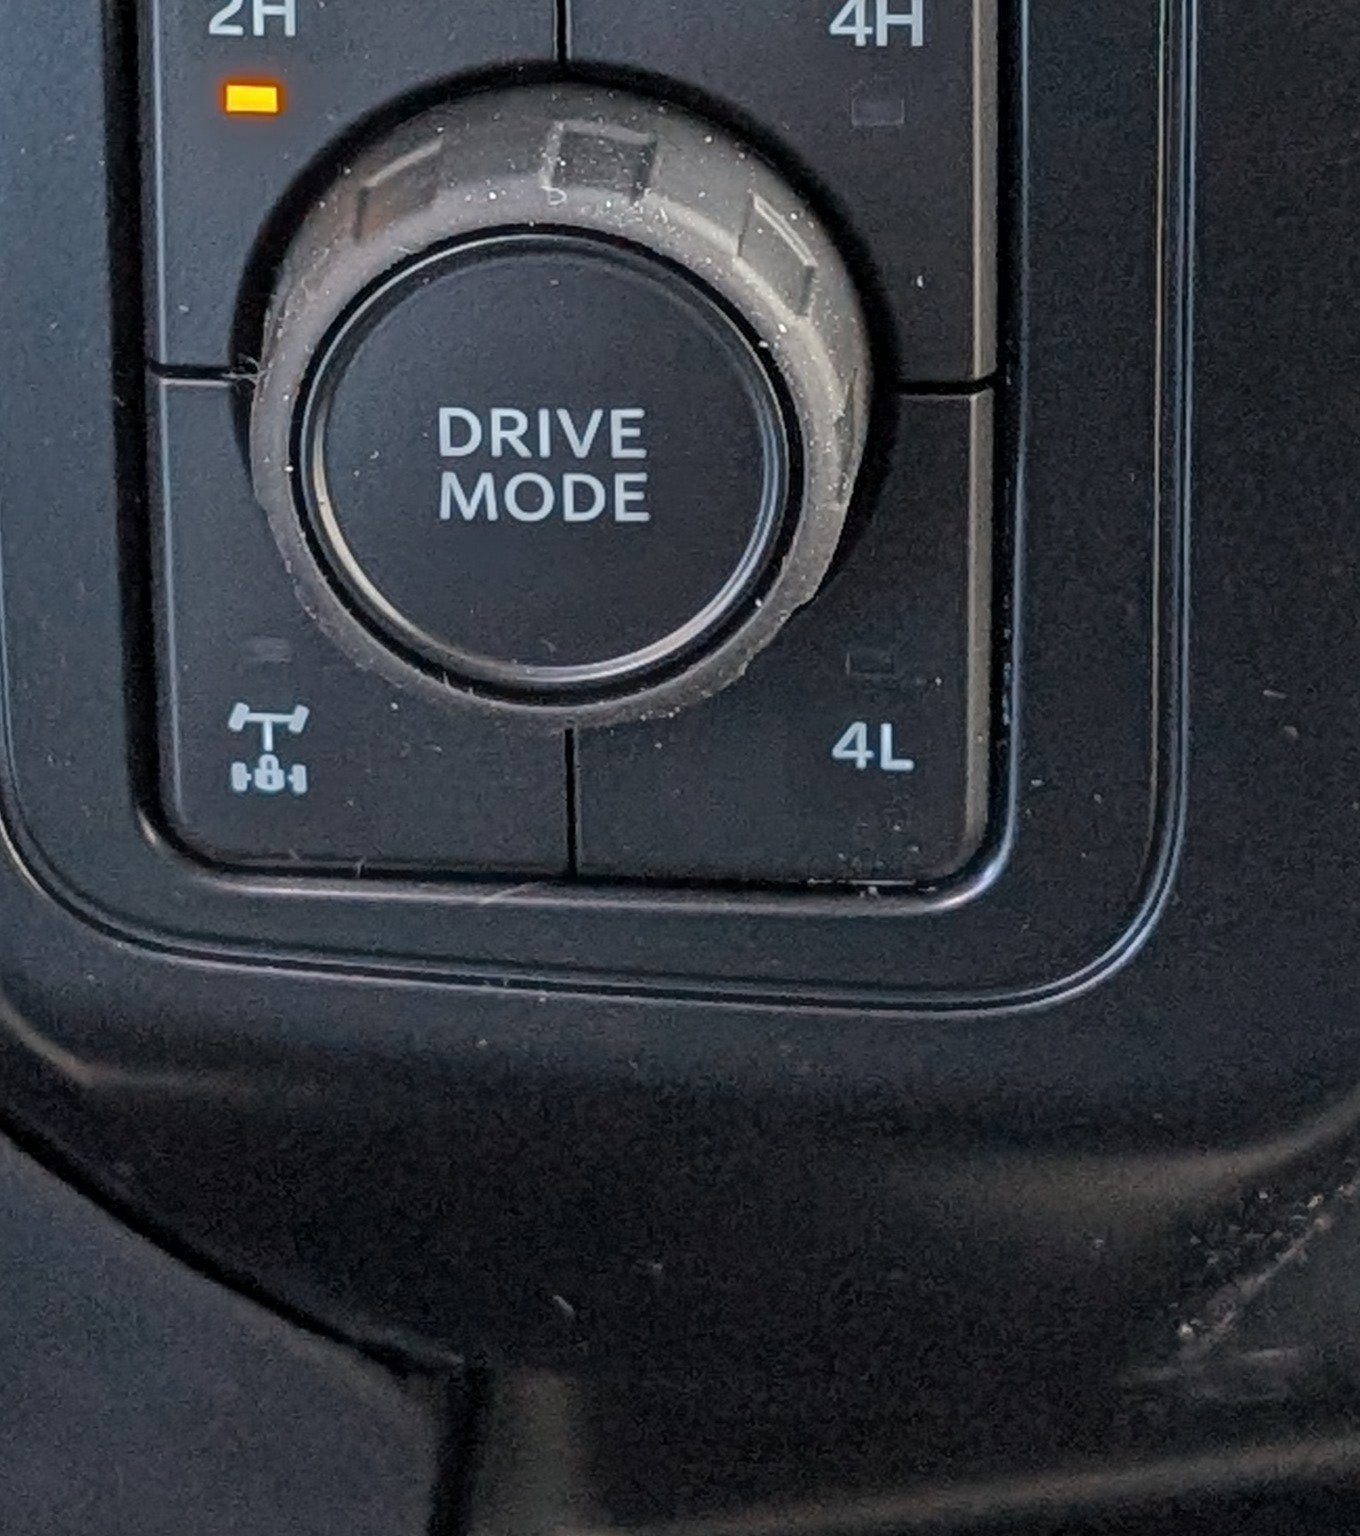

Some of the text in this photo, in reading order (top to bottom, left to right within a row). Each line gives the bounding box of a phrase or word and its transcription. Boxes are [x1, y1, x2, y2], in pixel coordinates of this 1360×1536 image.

[438, 406, 648, 459] DRIVE
[438, 471, 650, 522] MODE
[831, 721, 915, 771] 4L
